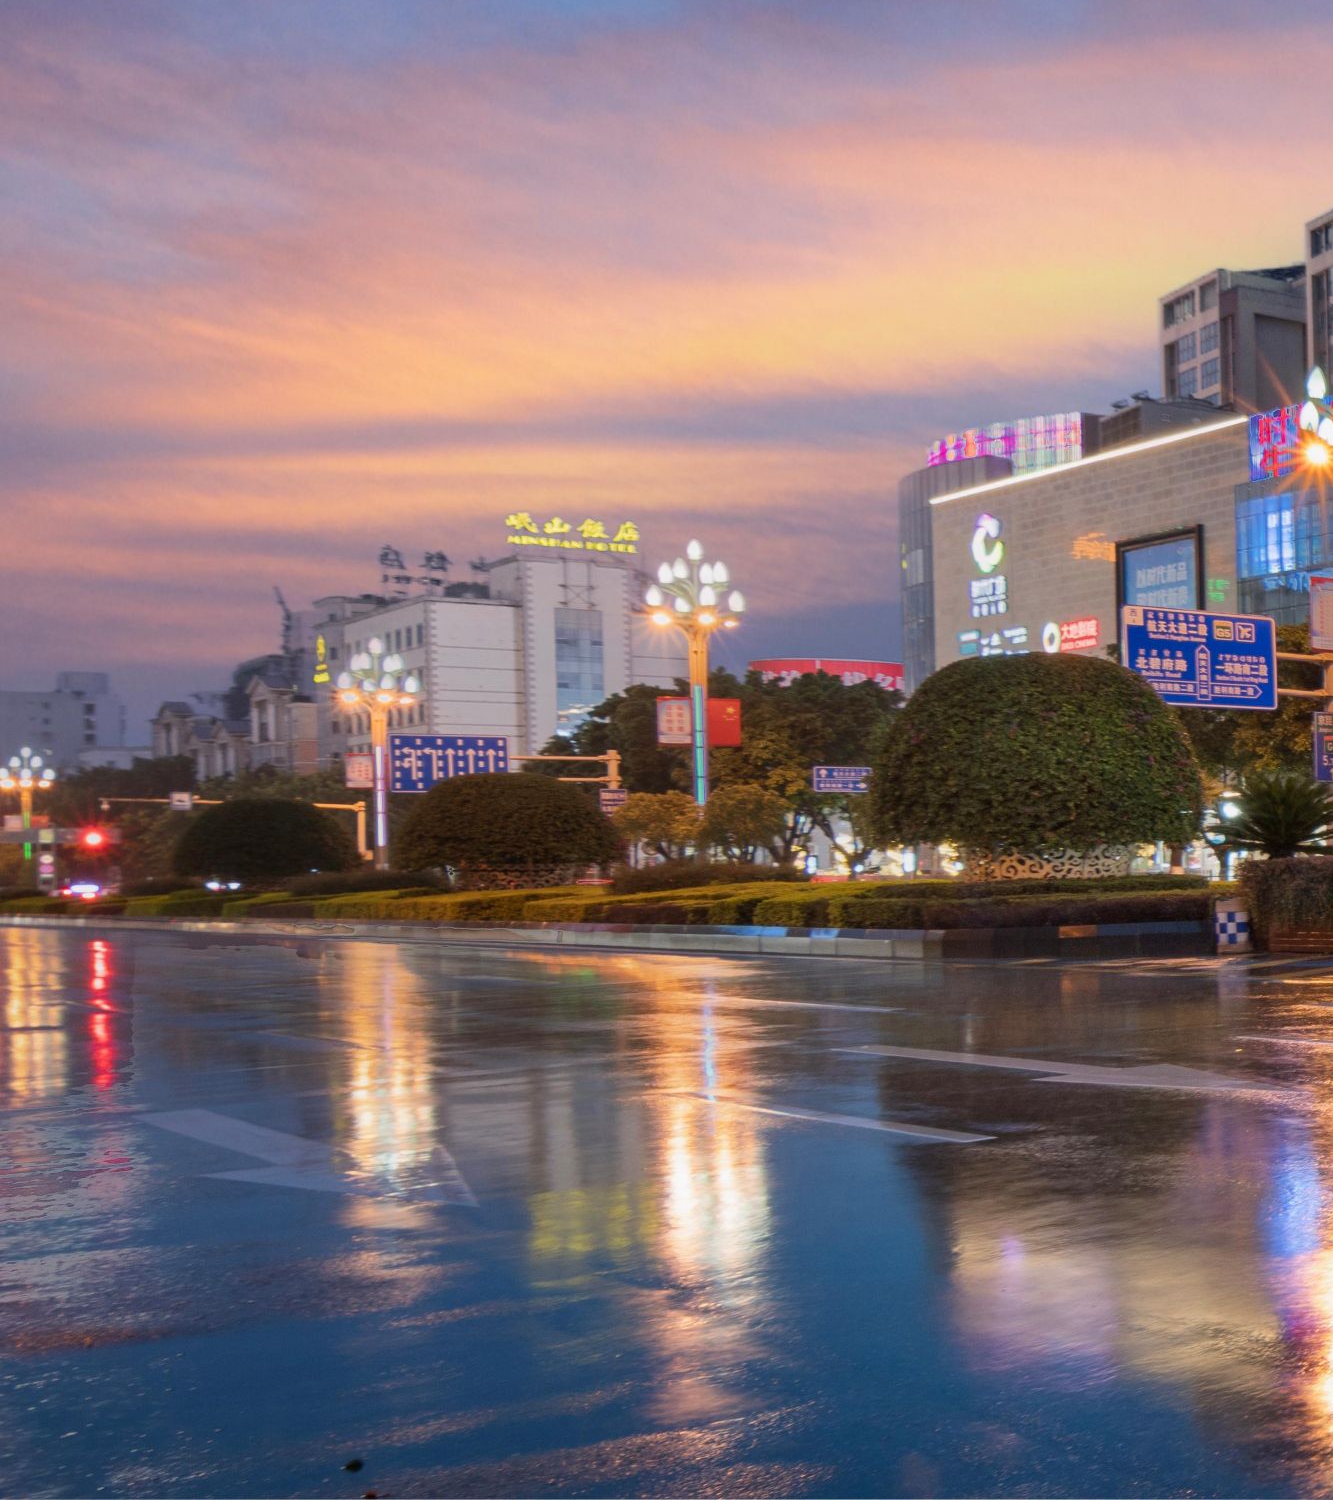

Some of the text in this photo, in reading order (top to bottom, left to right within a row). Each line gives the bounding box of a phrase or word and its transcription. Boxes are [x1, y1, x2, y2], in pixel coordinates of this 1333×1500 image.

[1060, 619, 1098, 640] 大地影院
[1146, 619, 1231, 638] 航天大道二段 G5
[1135, 656, 1188, 672] 北碧府路
